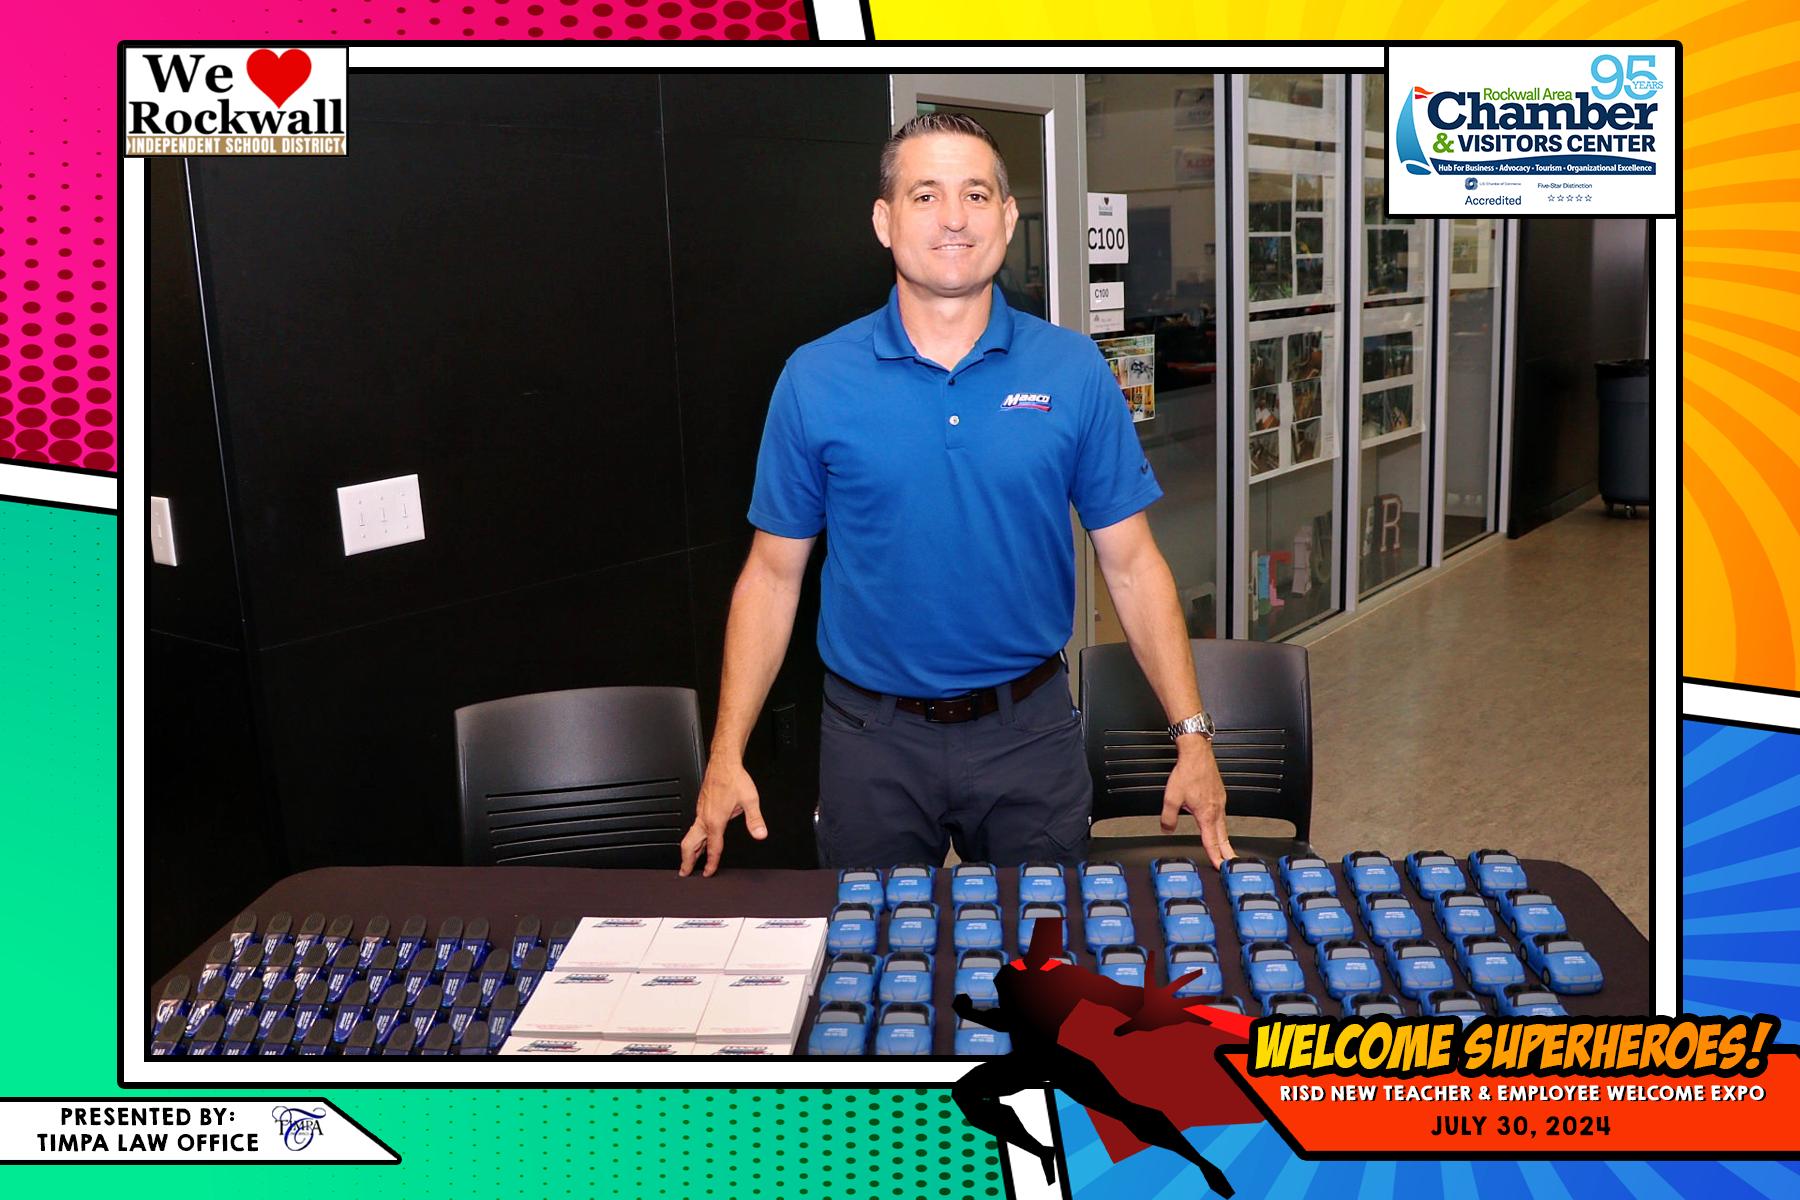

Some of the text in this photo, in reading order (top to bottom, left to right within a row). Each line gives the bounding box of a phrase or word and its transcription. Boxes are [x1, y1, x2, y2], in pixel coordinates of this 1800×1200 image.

[1087, 227, 1125, 250] C100
[1094, 288, 1109, 298] C100
[1003, 392, 1051, 406] Maaco
